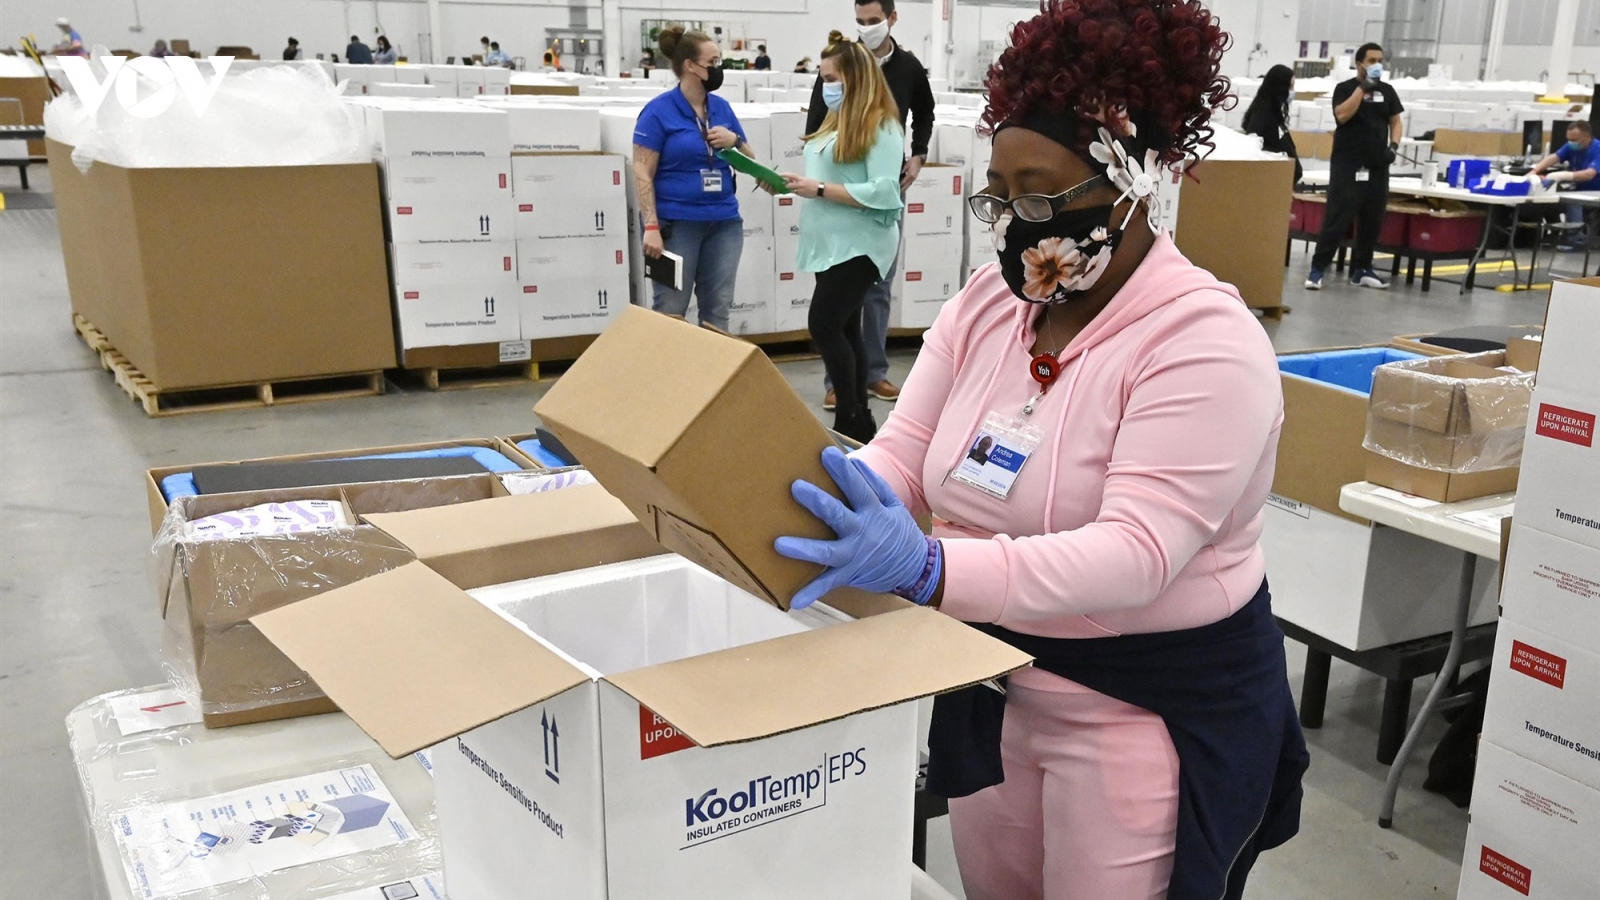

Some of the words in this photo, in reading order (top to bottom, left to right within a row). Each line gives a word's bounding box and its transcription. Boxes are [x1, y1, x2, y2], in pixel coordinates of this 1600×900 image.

[1037, 365, 1050, 377] Yoh
[1540, 420, 1560, 431] UPON
[1560, 424, 1589, 438] ARRIVAL
[1543, 411, 1589, 429] REFRIGERATE
[991, 454, 1012, 468] Coleman
[995, 447, 1013, 459] Andrea
[1544, 565, 1571, 578] RETURNED
[1513, 656, 1531, 668] UPON
[1534, 664, 1562, 681] ARRIVAL
[1517, 649, 1560, 671] REFRIGERATE
[1525, 720, 1574, 749] Temperature
[829, 747, 867, 784] EPS
[457, 737, 499, 783] Temperature
[499, 772, 533, 812] Sensitive
[533, 800, 564, 839] Product
[687, 816, 741, 841] INSULATED
[743, 799, 802, 824] CONTAINERS
[1482, 859, 1499, 873] UPON
[1502, 870, 1528, 889] ARRIVAL
[1486, 854, 1526, 879] REFRIGERATE
